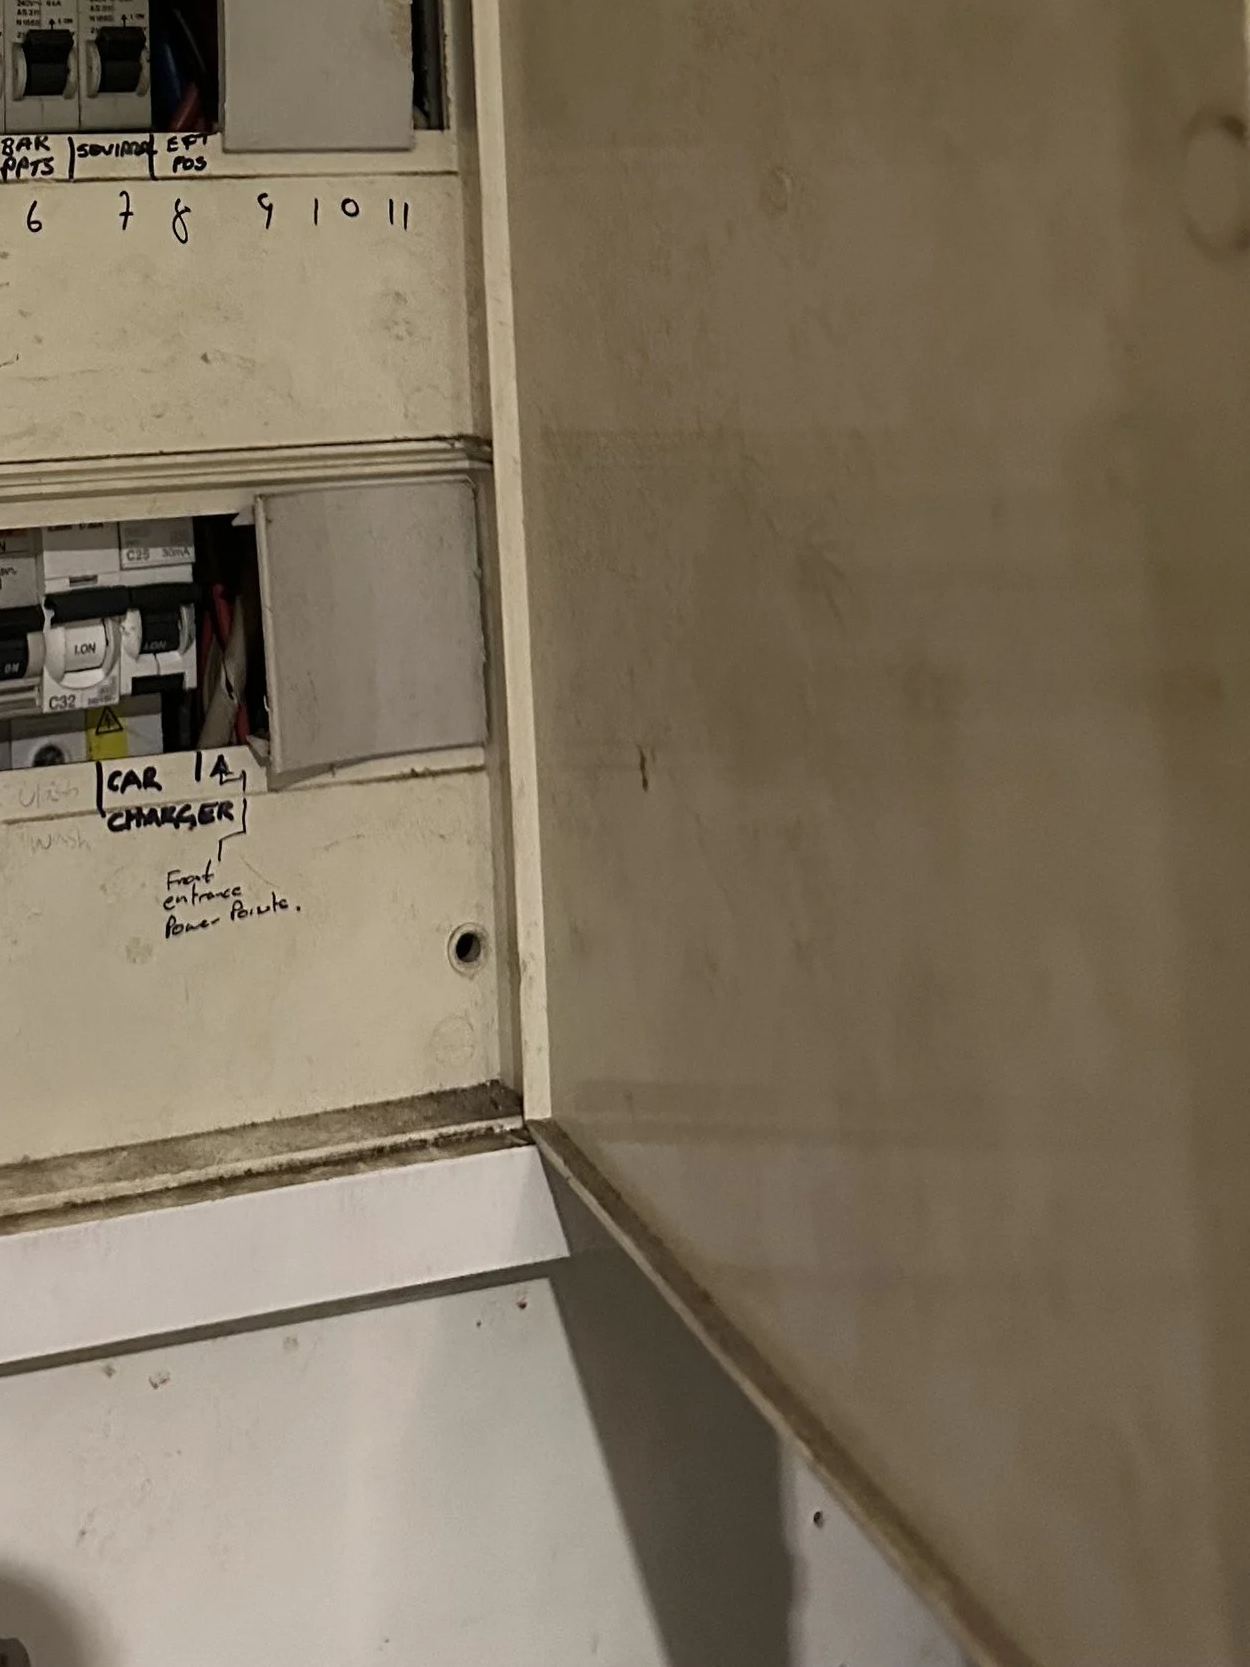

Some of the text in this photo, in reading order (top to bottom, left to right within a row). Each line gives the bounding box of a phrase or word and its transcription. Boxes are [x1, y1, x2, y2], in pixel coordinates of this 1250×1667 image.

[1, 135, 51, 156] BAR
[166, 132, 215, 153] EFT
[0, 155, 55, 182] PPTS
[172, 155, 208, 174] POS
[26, 200, 43, 233] 6
[118, 190, 134, 231] 7
[171, 198, 192, 245] 8
[257, 192, 274, 230] 9
[388, 198, 410, 231] 11
[49, 694, 77, 711] C32
[107, 766, 163, 794] CAR
[107, 800, 234, 833] CHARGER
[166, 859, 214, 890] Front
[163, 886, 243, 912] entrance
[165, 914, 221, 939] Power
